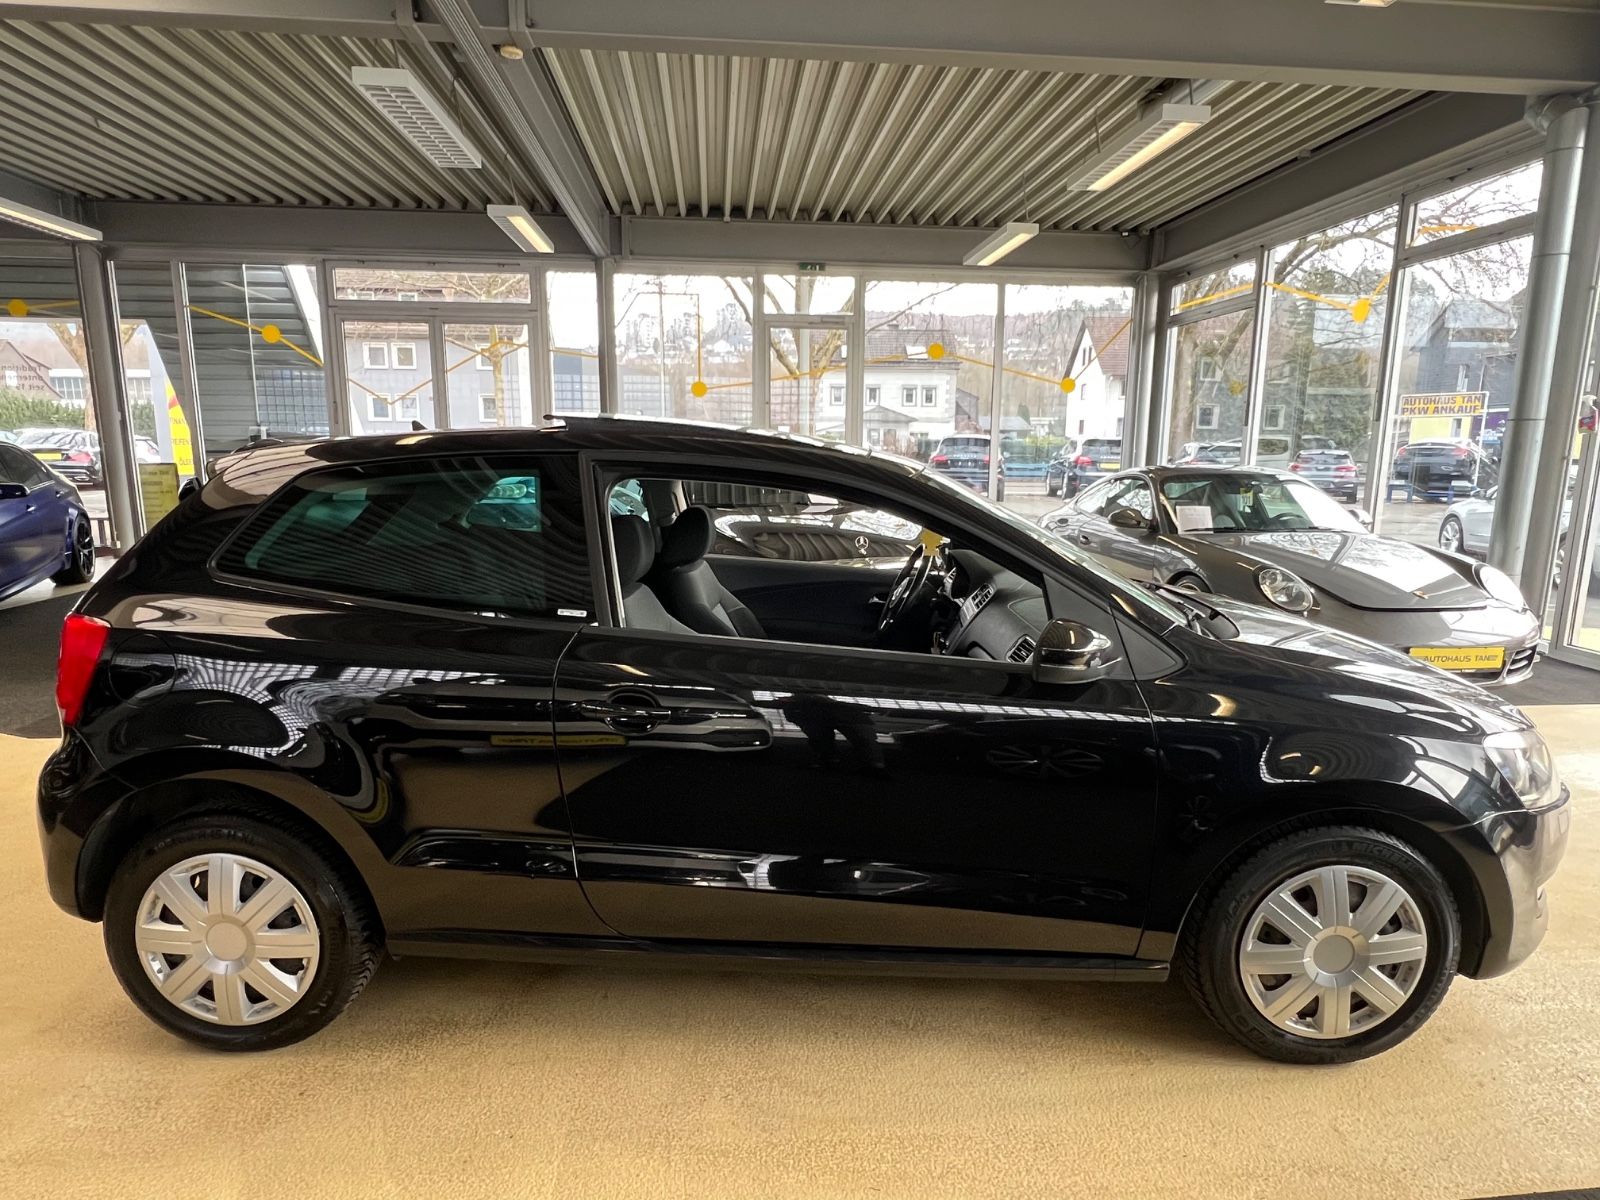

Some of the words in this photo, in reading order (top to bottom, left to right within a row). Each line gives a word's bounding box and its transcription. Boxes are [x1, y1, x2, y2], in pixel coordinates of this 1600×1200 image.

[1404, 396, 1457, 406] AUTOHAUS
[1461, 395, 1482, 404] TAN
[1402, 406, 1429, 415] PKW
[1432, 405, 1480, 414] ANKAUF
[1423, 655, 1472, 663] AUTOHAUS
